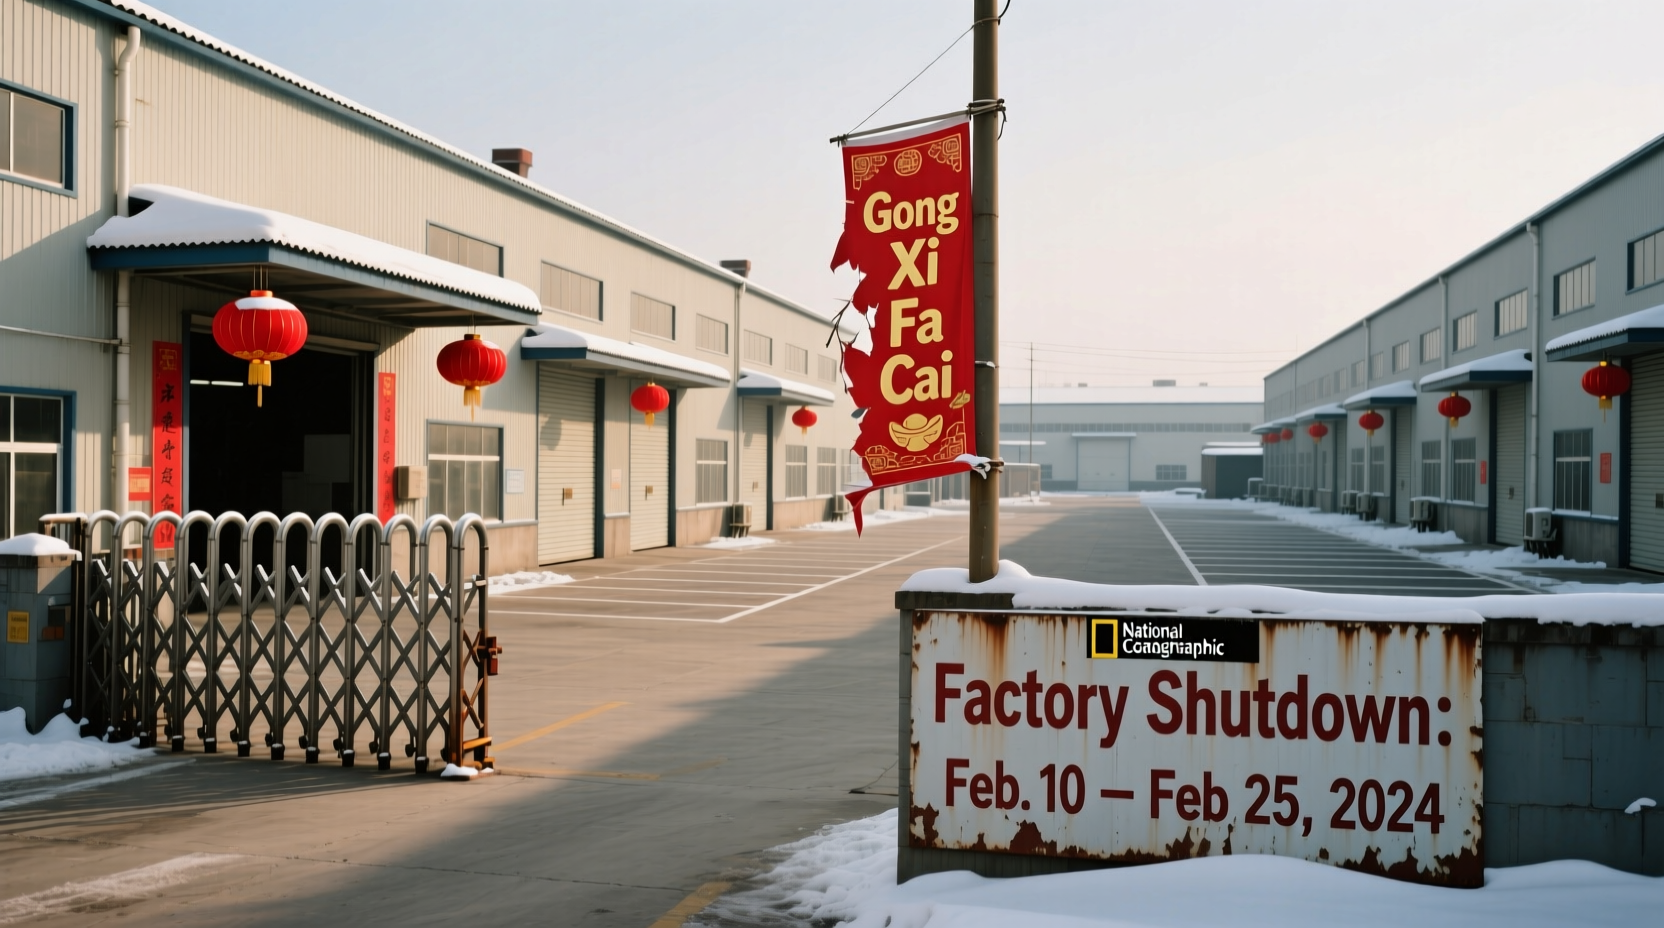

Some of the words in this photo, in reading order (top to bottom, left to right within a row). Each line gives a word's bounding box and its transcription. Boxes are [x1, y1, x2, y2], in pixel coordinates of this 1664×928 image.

[863, 191, 960, 235] Gong
[887, 237, 940, 290] Xi
[890, 297, 944, 347] Fa
[880, 350, 953, 405] Cai
[1122, 622, 1183, 639] National
[934, 662, 1129, 749] Factory
[1146, 669, 1453, 747] Shutdown:
[945, 757, 1031, 812] Feb.
[1039, 763, 1087, 815] 10
[1149, 768, 1230, 823] Feb
[1244, 773, 1313, 838] 25,
[1329, 777, 1445, 835] 2024
